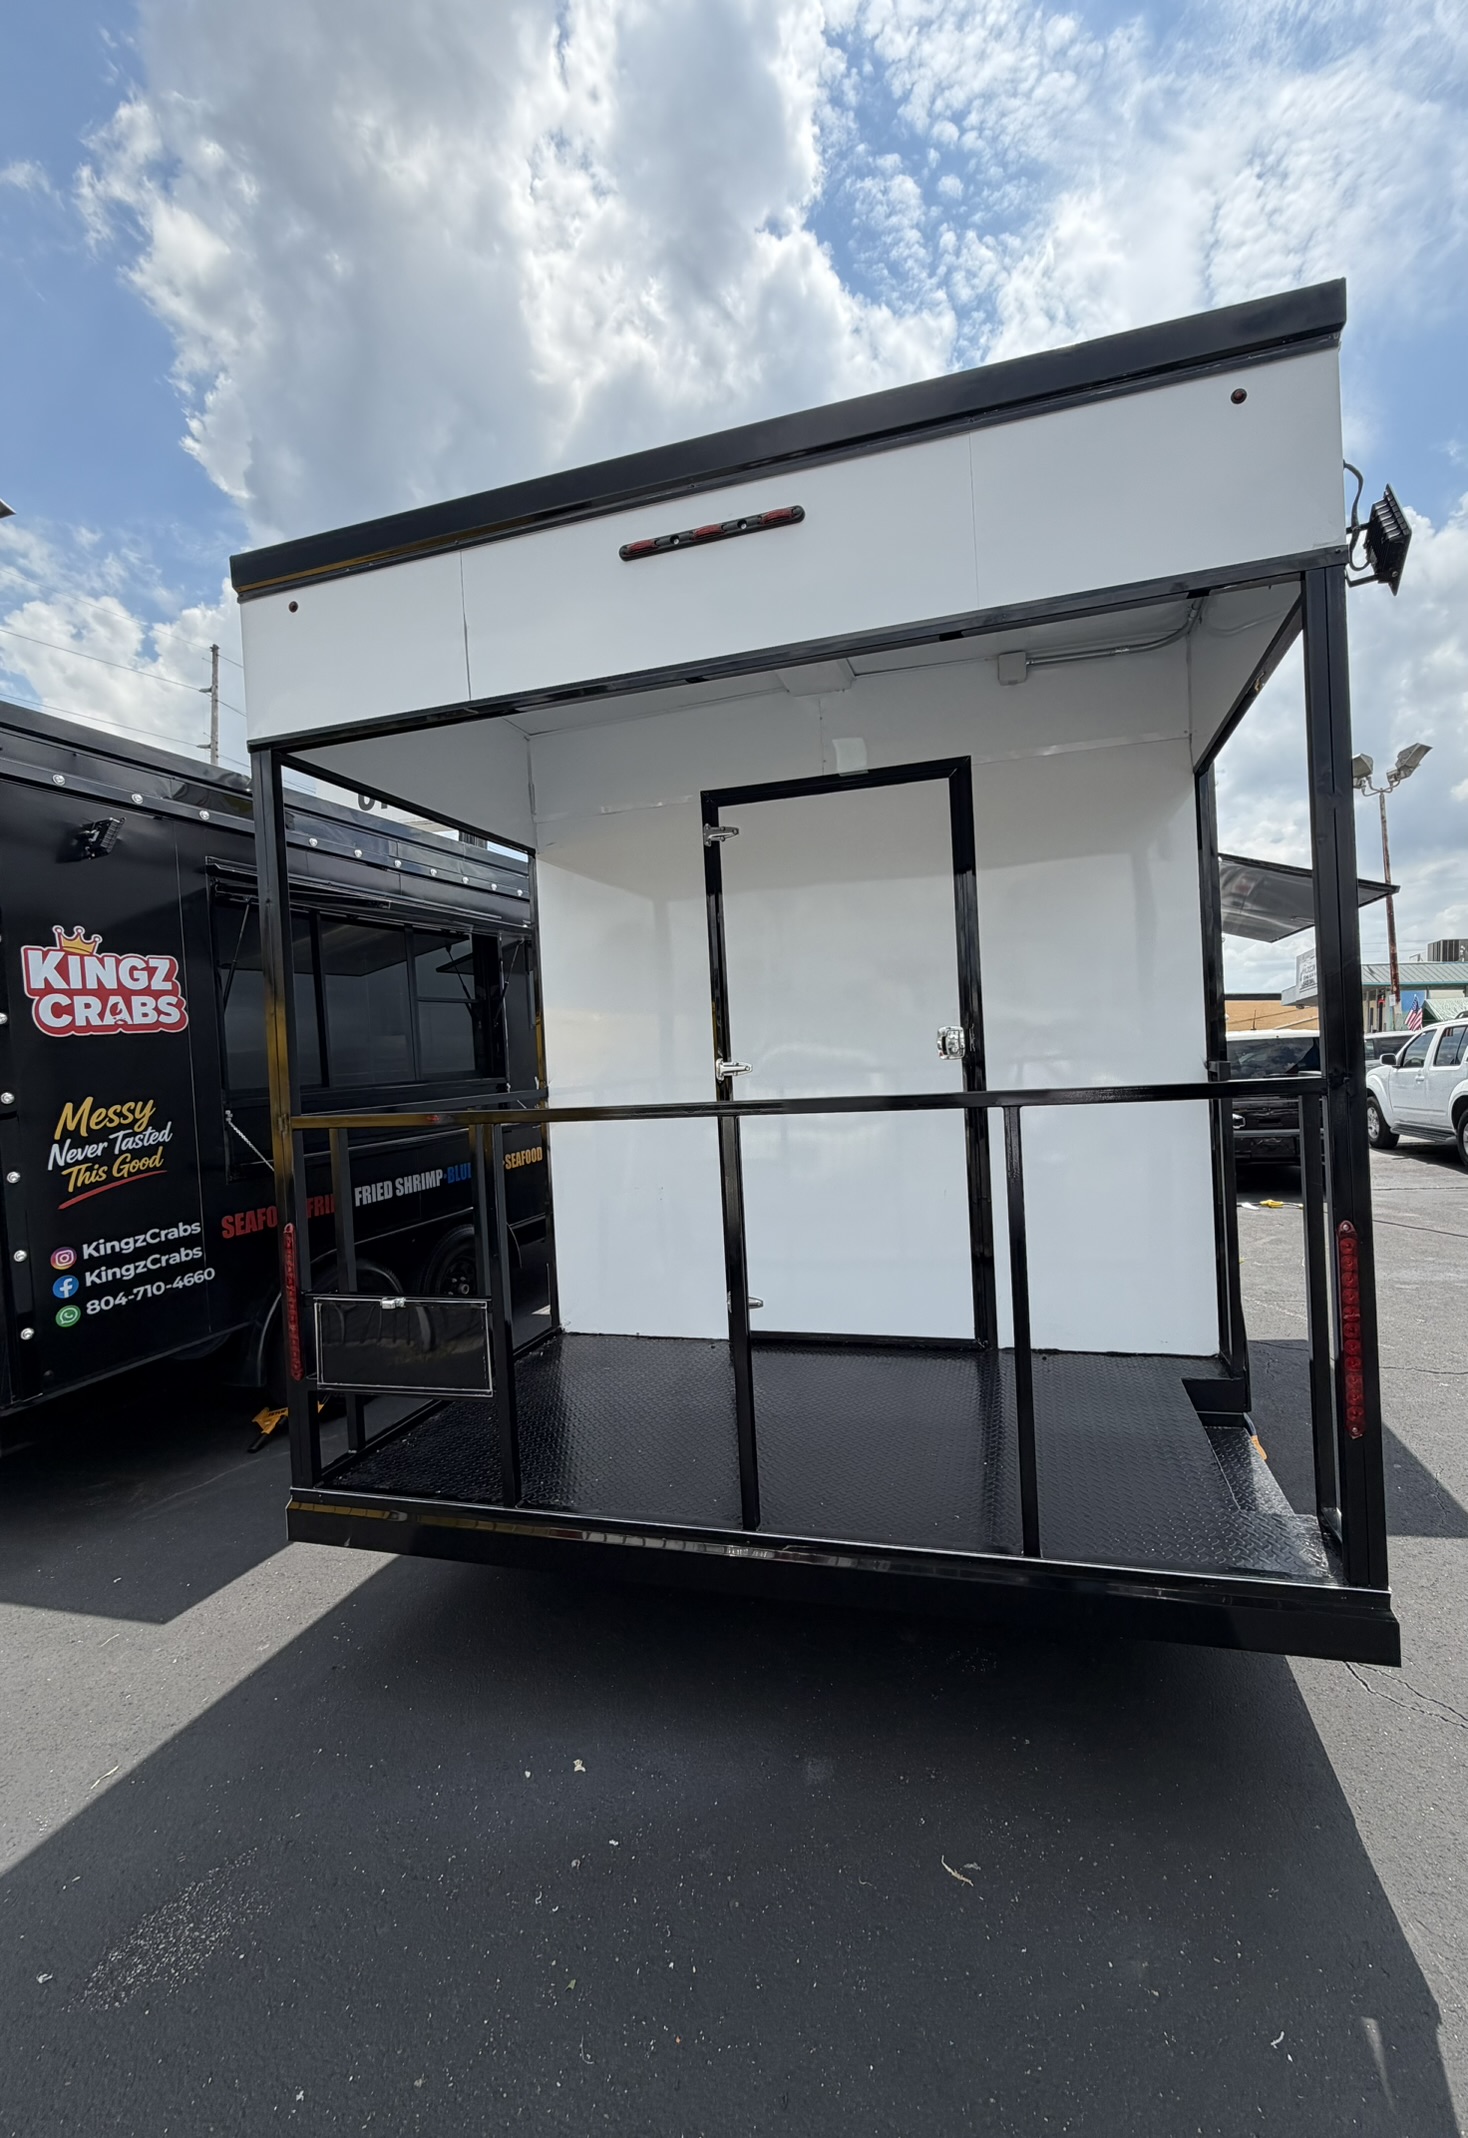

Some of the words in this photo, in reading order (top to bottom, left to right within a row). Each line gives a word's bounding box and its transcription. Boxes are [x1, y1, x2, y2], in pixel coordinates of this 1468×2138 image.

[27, 950, 173, 990] KINGZ
[38, 994, 181, 1028] CRABS
[54, 1096, 156, 1140] Messy
[47, 1138, 108, 1171] Never
[108, 1121, 173, 1154] Tasted
[61, 1162, 108, 1192] This
[112, 1146, 164, 1177] Good
[221, 1205, 278, 1239] SEAFO
[354, 1181, 393, 1207] FRIED
[395, 1169, 443, 1196] SHRIMP
[505, 1146, 543, 1170] SEAFOOD
[82, 1222, 202, 1260] KingzCrabs
[85, 1246, 203, 1287] KingzCrabs
[86, 1267, 216, 1315] 804-710-4660
